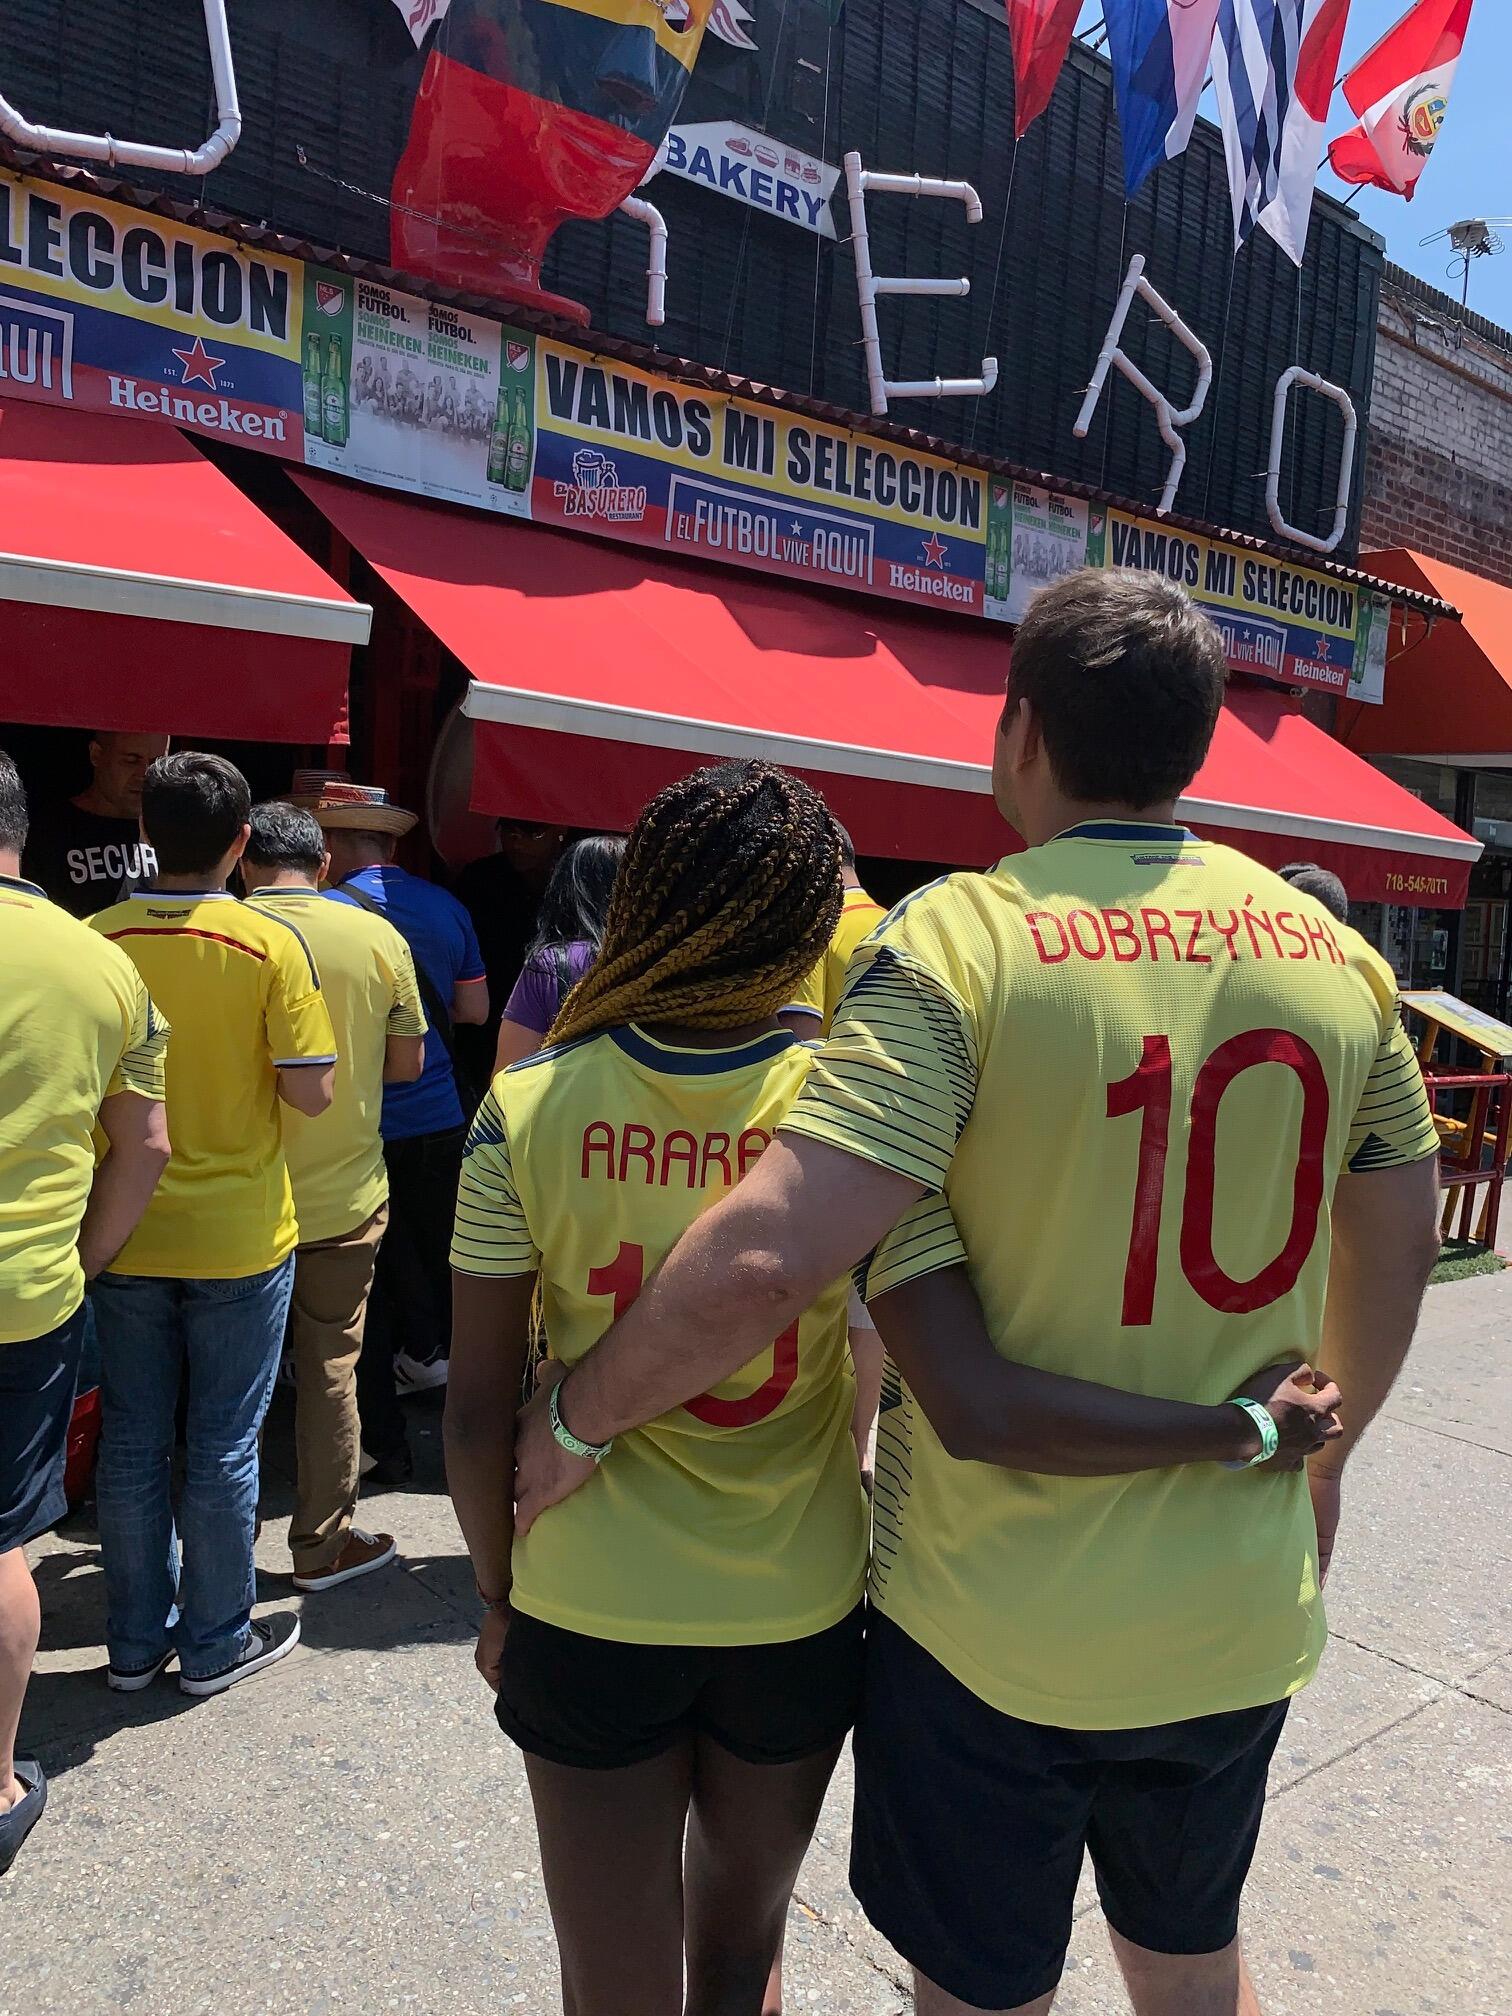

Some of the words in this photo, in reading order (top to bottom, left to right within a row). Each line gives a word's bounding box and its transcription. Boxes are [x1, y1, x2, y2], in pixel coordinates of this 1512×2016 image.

[667, 132, 826, 226] BAKERY
[358, 282, 391, 301] SOMOS
[358, 294, 410, 323] FUTBOL.
[358, 311, 391, 328] SOMOS
[428, 317, 477, 344] FUTBOL.
[357, 321, 425, 355] HEINEKEN.
[0, 324, 52, 389] UI
[427, 342, 491, 374] HEINEKEN.
[108, 375, 286, 441] Heineken
[545, 354, 711, 457] VAMOS
[723, 408, 775, 475] MI
[787, 427, 981, 529] SELECCION
[554, 482, 568, 496] EL
[565, 487, 645, 514] BASURERO
[608, 512, 642, 520] RESTAURANT
[1048, 502, 1074, 518] FUTBOL.
[677, 514, 691, 540] EL
[693, 499, 781, 561] FUTBOL
[782, 538, 809, 566] VIVE
[812, 528, 865, 578] AQUI
[889, 564, 974, 603] Heineken
[1112, 520, 1199, 587] VAMOS
[1204, 549, 1236, 596] MI
[1242, 560, 1353, 630] SELECCION
[1237, 641, 1254, 662] VIVE
[1293, 658, 1344, 686] Heineken
[67, 843, 158, 884] SECUR
[1025, 894, 1346, 966] DOBRZYŃSKI
[581, 1121, 777, 1188] ARARA
[1106, 1027, 1330, 1326] 10
